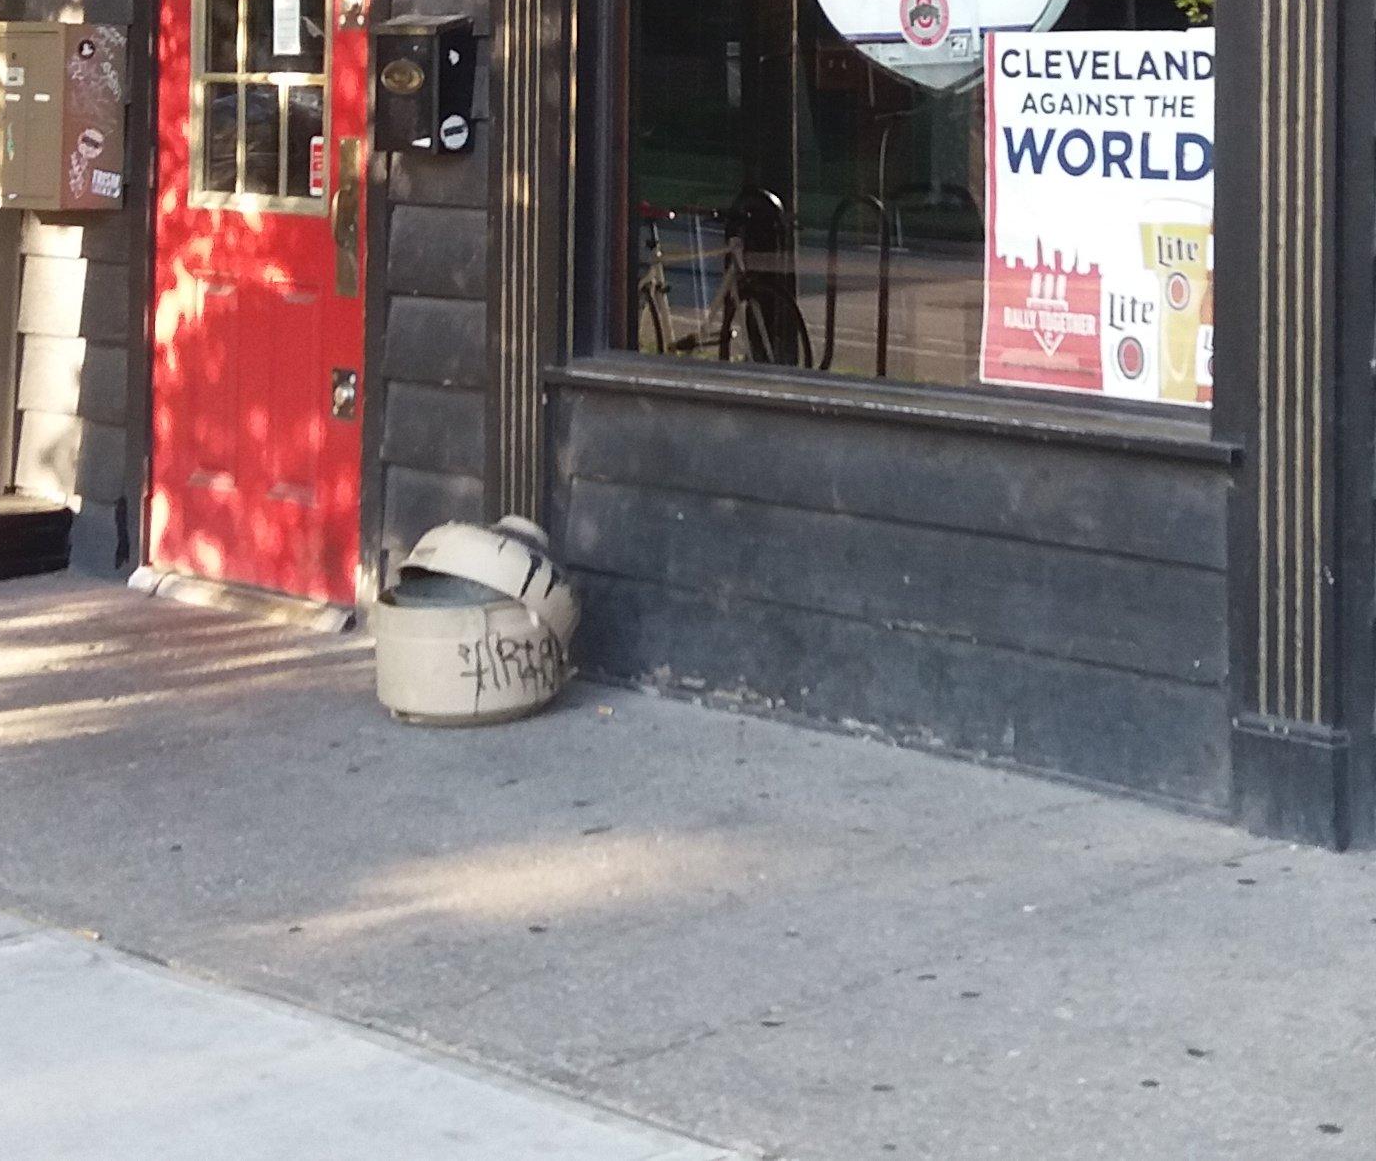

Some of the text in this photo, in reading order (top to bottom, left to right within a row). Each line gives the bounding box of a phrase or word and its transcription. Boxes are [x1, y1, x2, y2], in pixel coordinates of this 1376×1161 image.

[1000, 48, 1214, 81] CLEVELAND
[1021, 92, 1195, 118] AGAINST THE
[1003, 126, 1214, 181] WORLD
[1157, 235, 1199, 267] Lite
[1108, 291, 1154, 331] Lite
